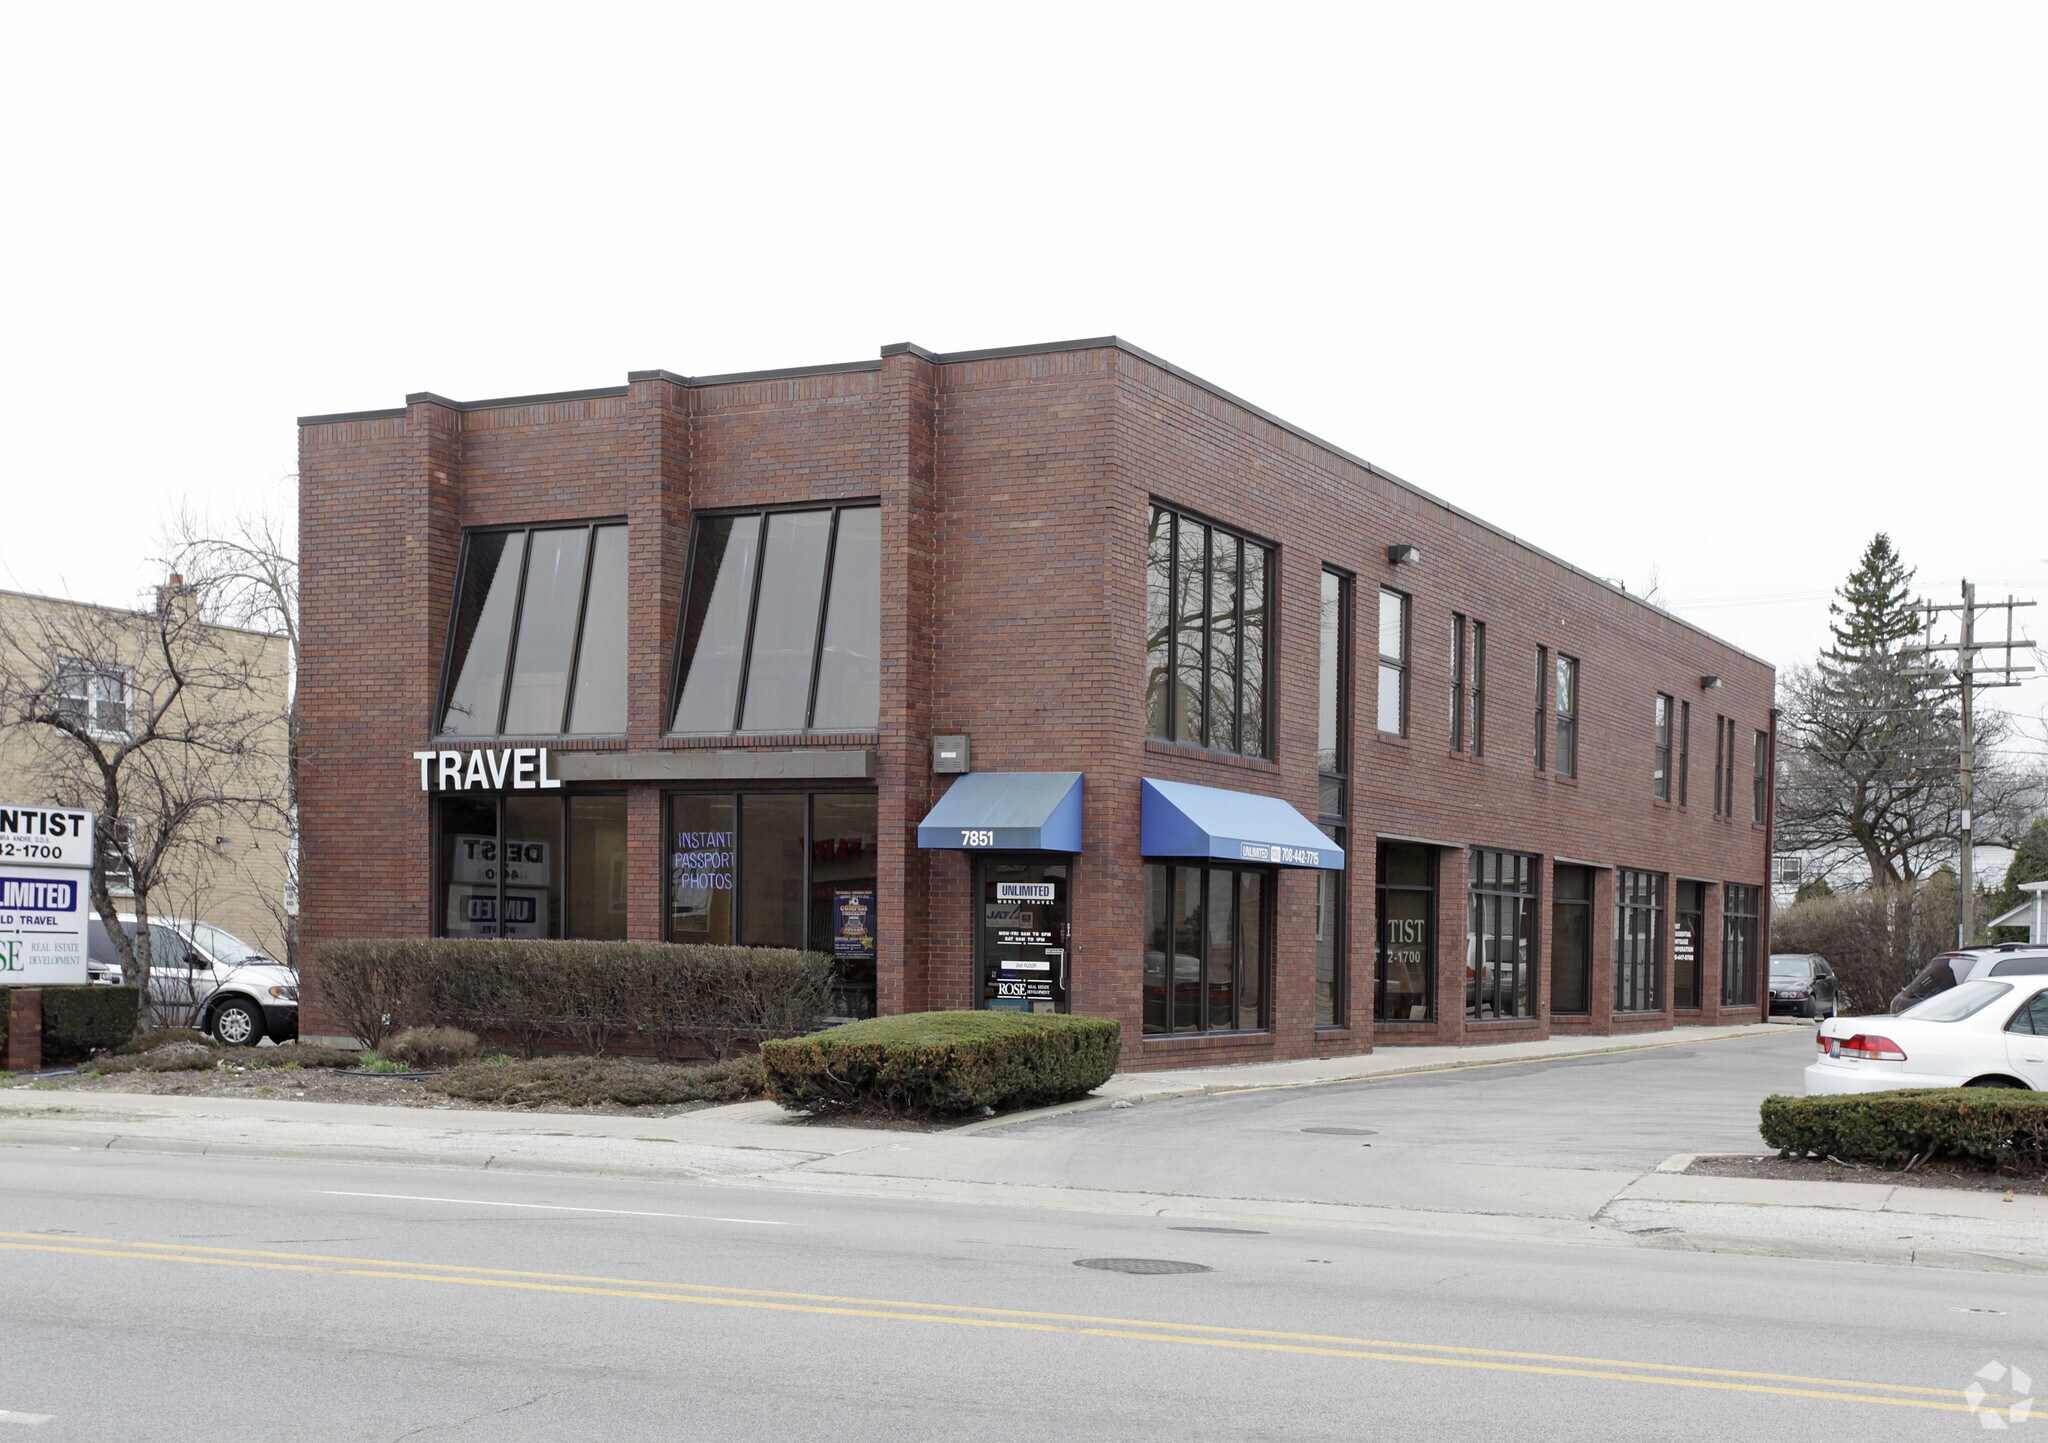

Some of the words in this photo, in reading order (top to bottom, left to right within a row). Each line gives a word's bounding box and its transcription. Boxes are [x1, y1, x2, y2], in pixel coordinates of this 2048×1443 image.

[413, 748, 561, 791] TRAVEL
[0, 809, 85, 837] NTIST
[678, 831, 734, 849] INSTANT
[961, 830, 994, 846] 7851
[675, 852, 734, 869] PASSPORT
[1242, 846, 1269, 859] UNLIMITED
[681, 873, 732, 890] PHOTOS
[0, 881, 71, 909] IMITED
[1002, 885, 1050, 897] UNLIMITED
[20, 915, 58, 926] TRAVEL
[1387, 919, 1425, 943] TIST
[31, 942, 50, 951] REAL
[54, 943, 79, 952] ESTATE
[29, 956, 80, 965] DEVELOPMENT
[1387, 950, 1421, 963] 2-1700
[998, 983, 1027, 995] ROSE
